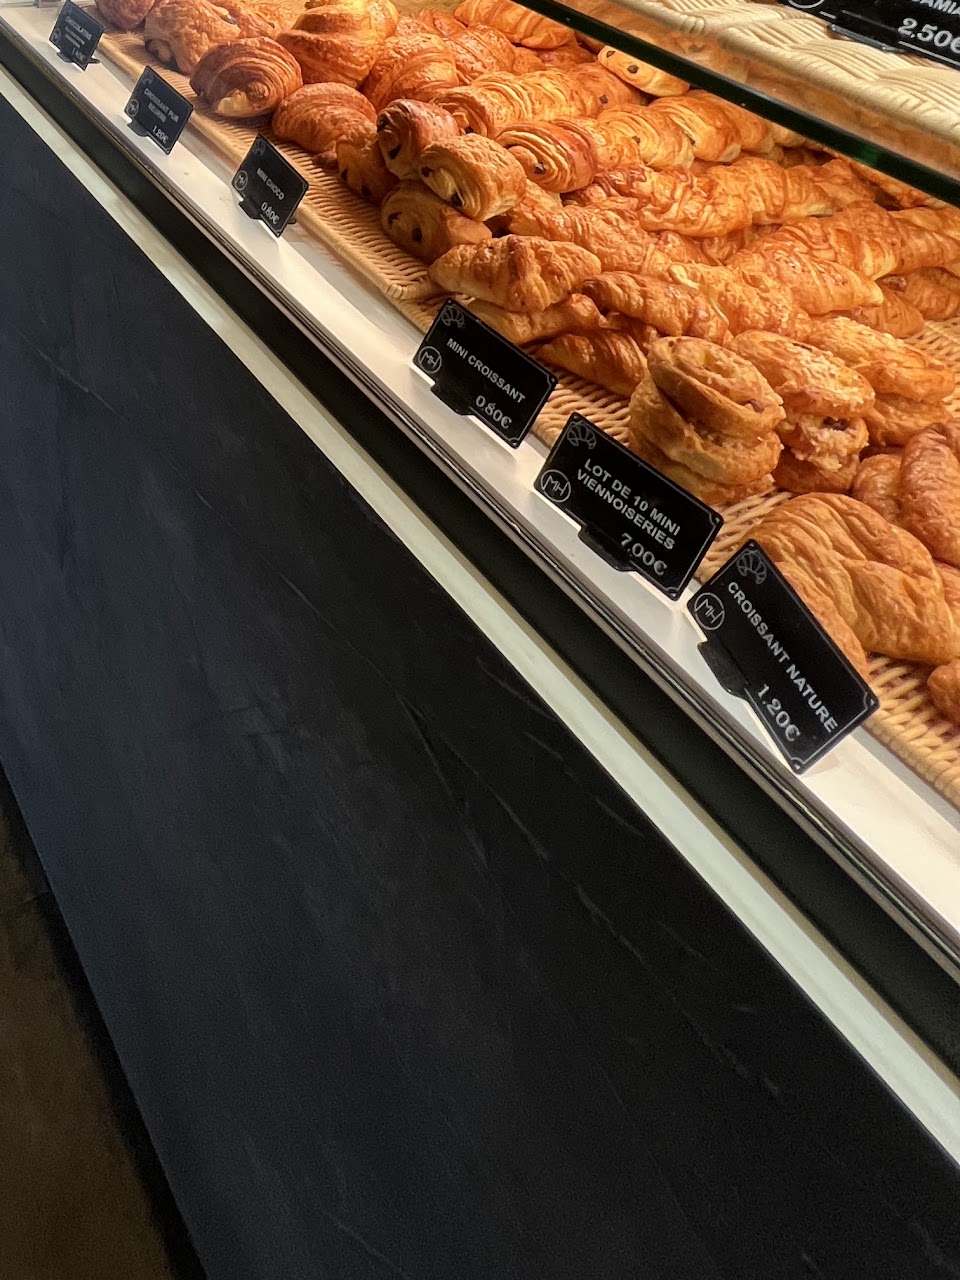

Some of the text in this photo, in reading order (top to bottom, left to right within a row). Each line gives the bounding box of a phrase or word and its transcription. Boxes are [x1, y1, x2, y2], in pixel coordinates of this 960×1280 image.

[265, 178, 285, 200] CHOCO
[446, 337, 526, 404] MINI CROISSANT
[475, 395, 513, 429] 0.80€
[576, 468, 676, 551] VIENNOISERIES
[584, 458, 681, 537] LOT DE 10 MINI
[620, 532, 668, 576] 7.00€
[728, 581, 838, 733] CROISSANT NATURE
[756, 683, 801, 742] 1.20€
